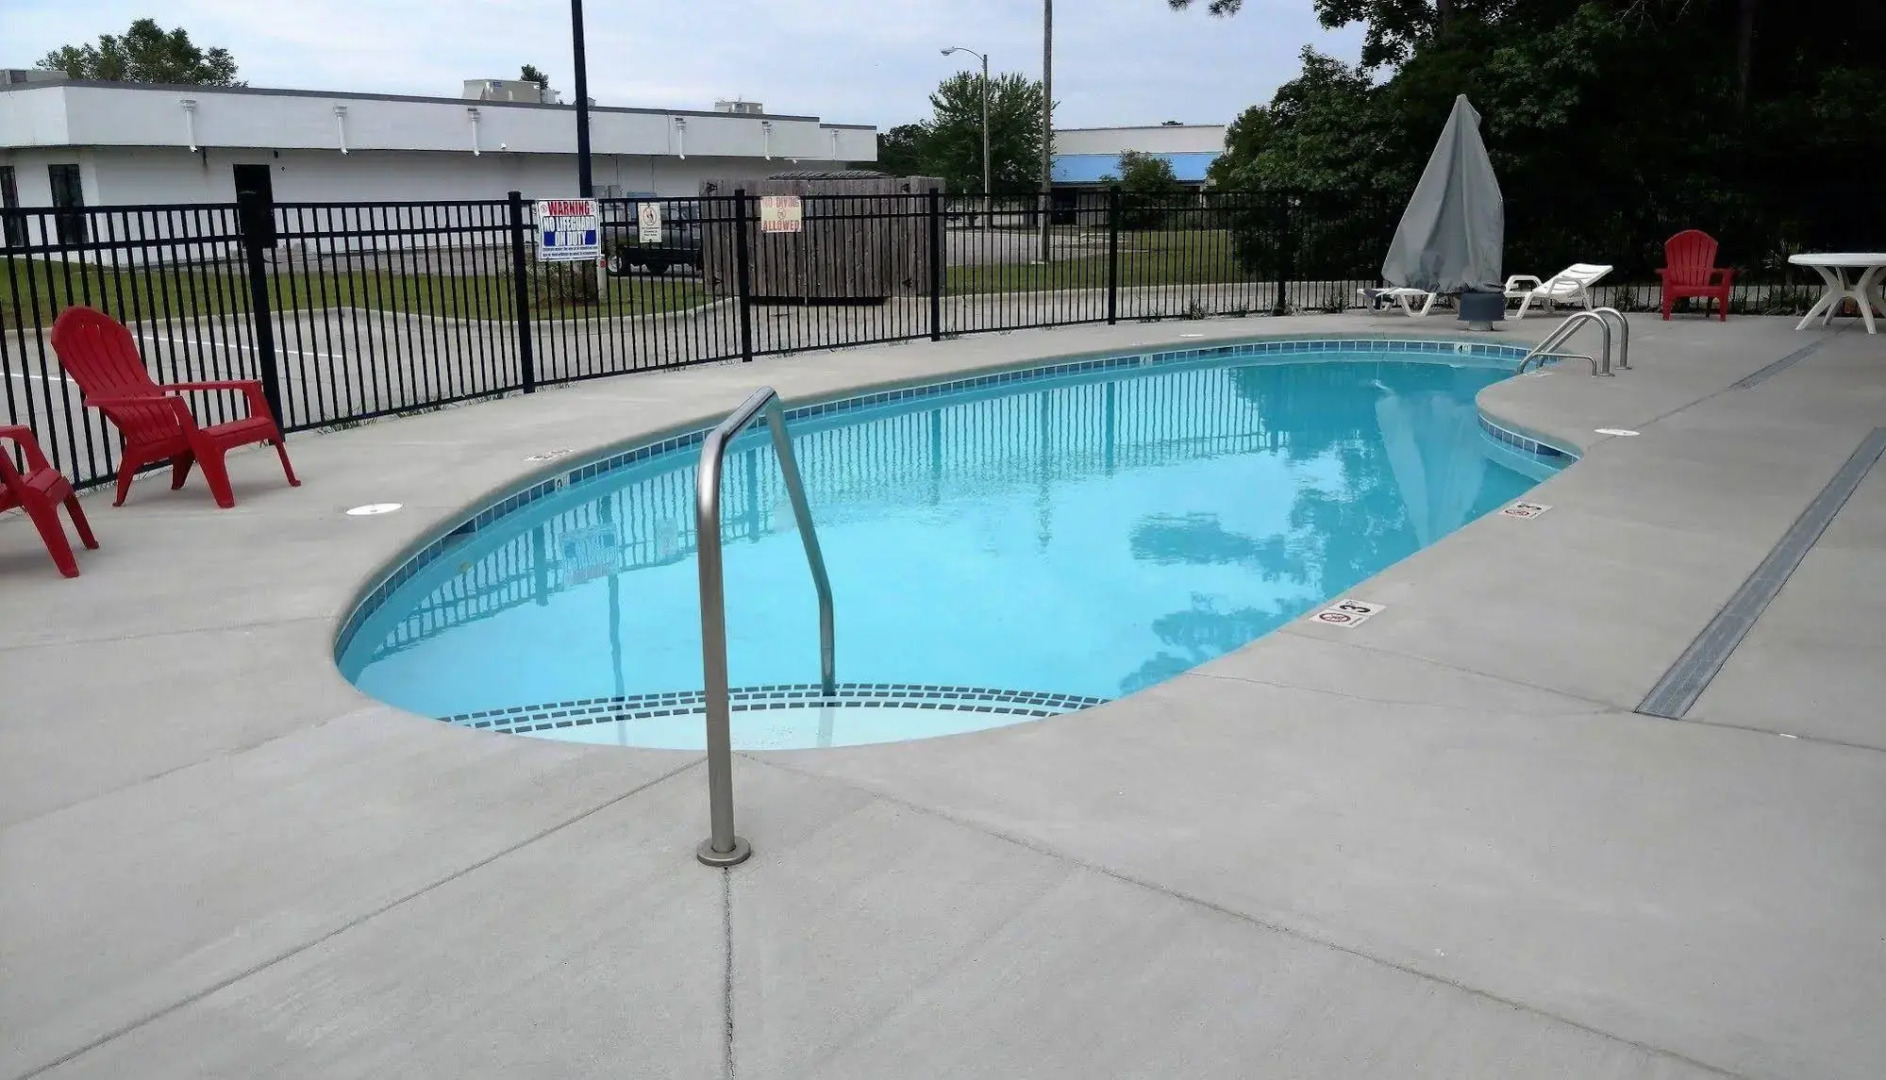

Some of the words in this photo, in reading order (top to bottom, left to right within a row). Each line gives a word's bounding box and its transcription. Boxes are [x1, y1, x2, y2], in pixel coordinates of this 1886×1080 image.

[547, 200, 590, 216] WARNING
[543, 217, 555, 232] NO
[556, 216, 596, 232] LIFEGUARD
[763, 219, 799, 230] ALLOWED
[555, 231, 566, 246] ON
[567, 230, 586, 246] DUTY
